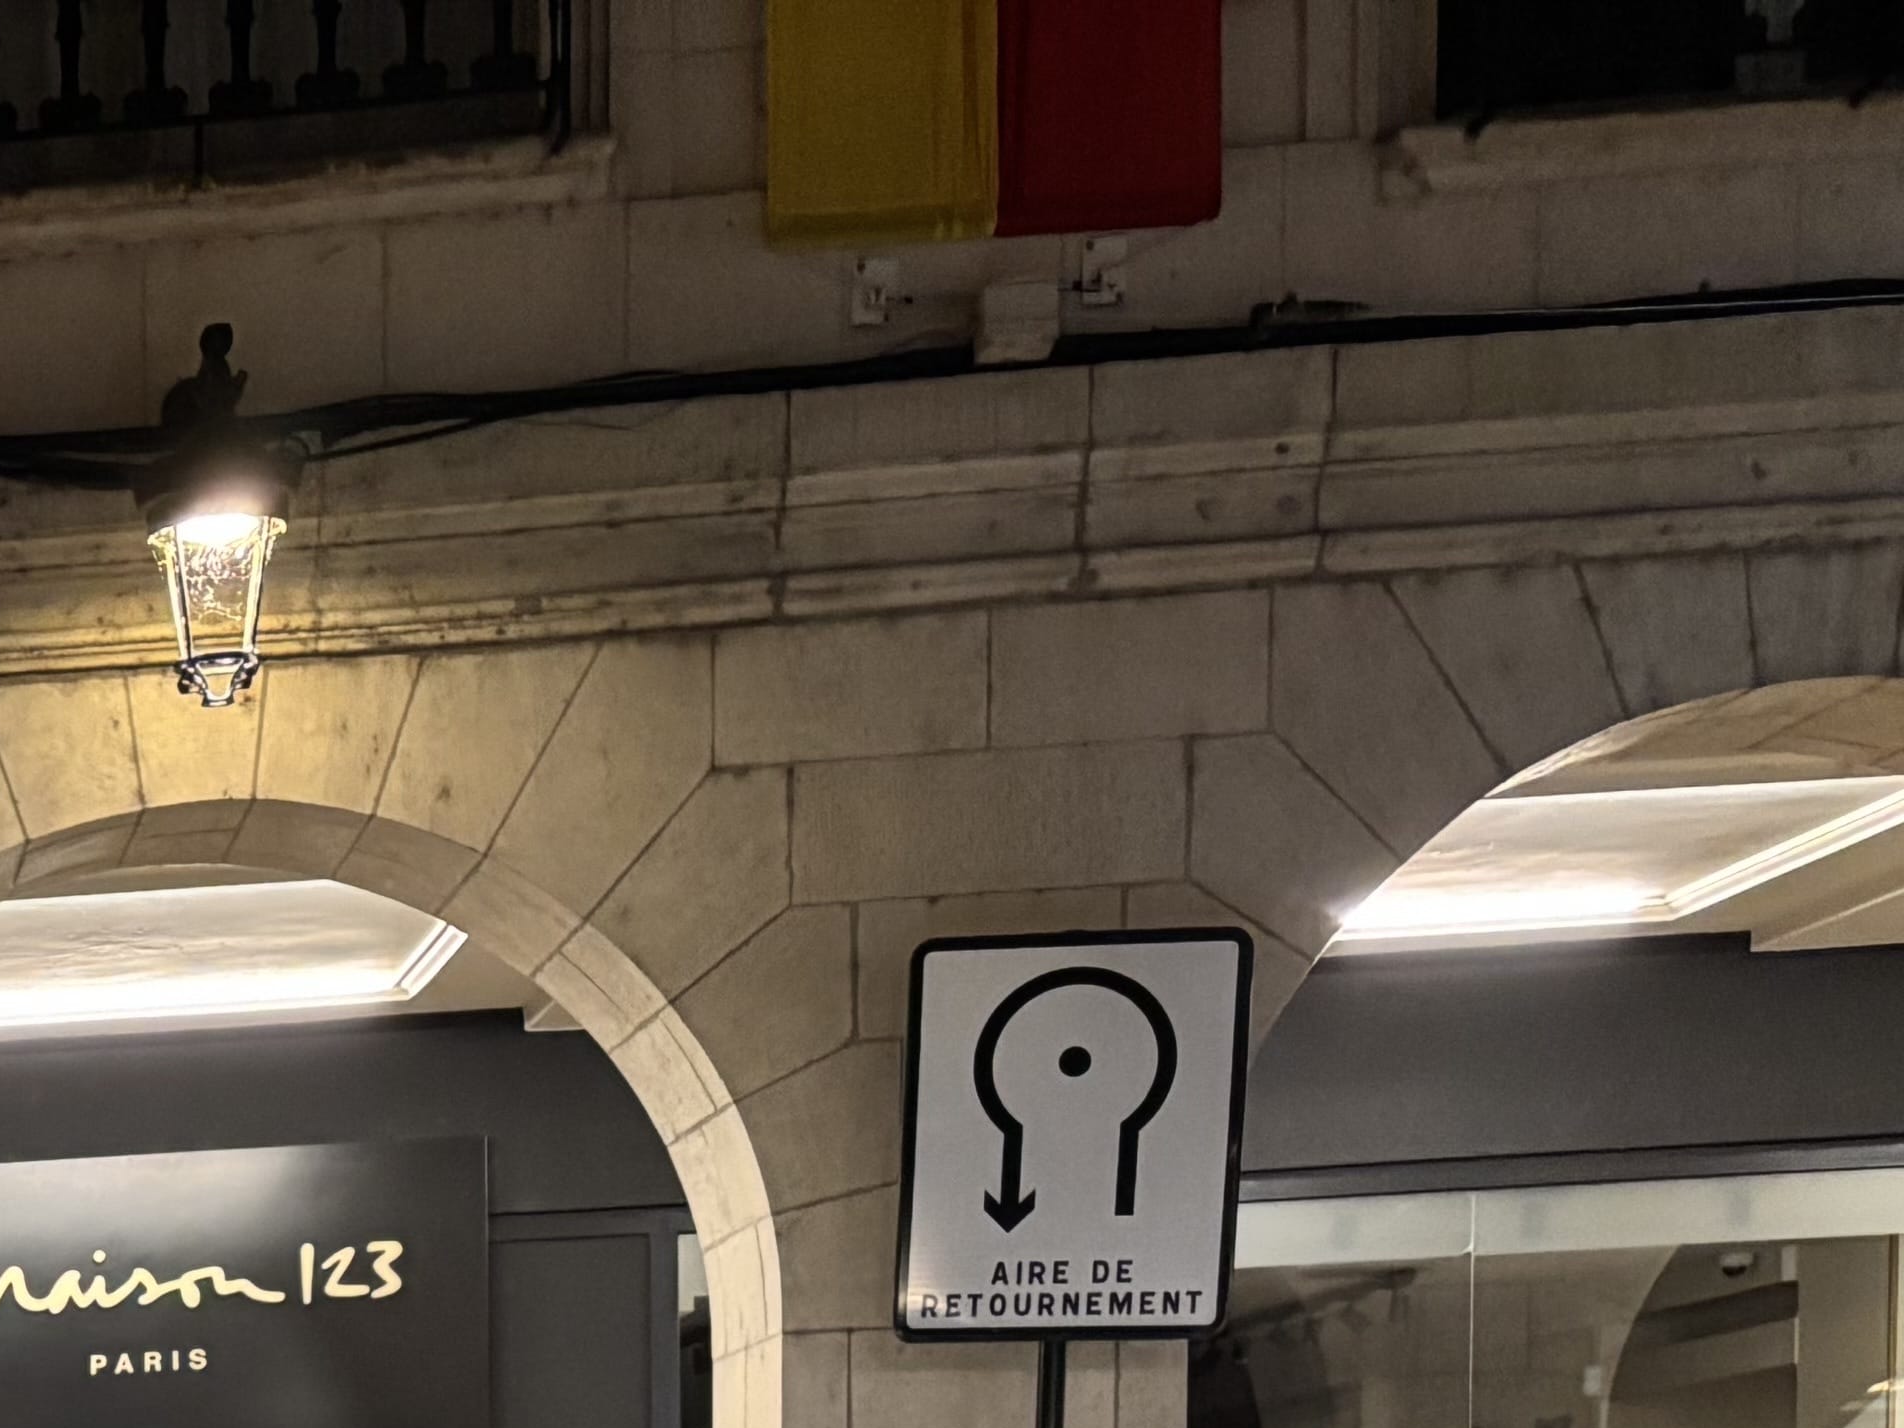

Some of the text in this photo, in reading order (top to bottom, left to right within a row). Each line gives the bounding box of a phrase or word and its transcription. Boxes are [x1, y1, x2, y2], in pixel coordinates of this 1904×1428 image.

[299, 1240, 403, 1304] 123
[991, 1259, 1134, 1286] AIRE DE
[920, 1290, 1203, 1319] RETOURNEMENT
[89, 1347, 208, 1376] PARIS
